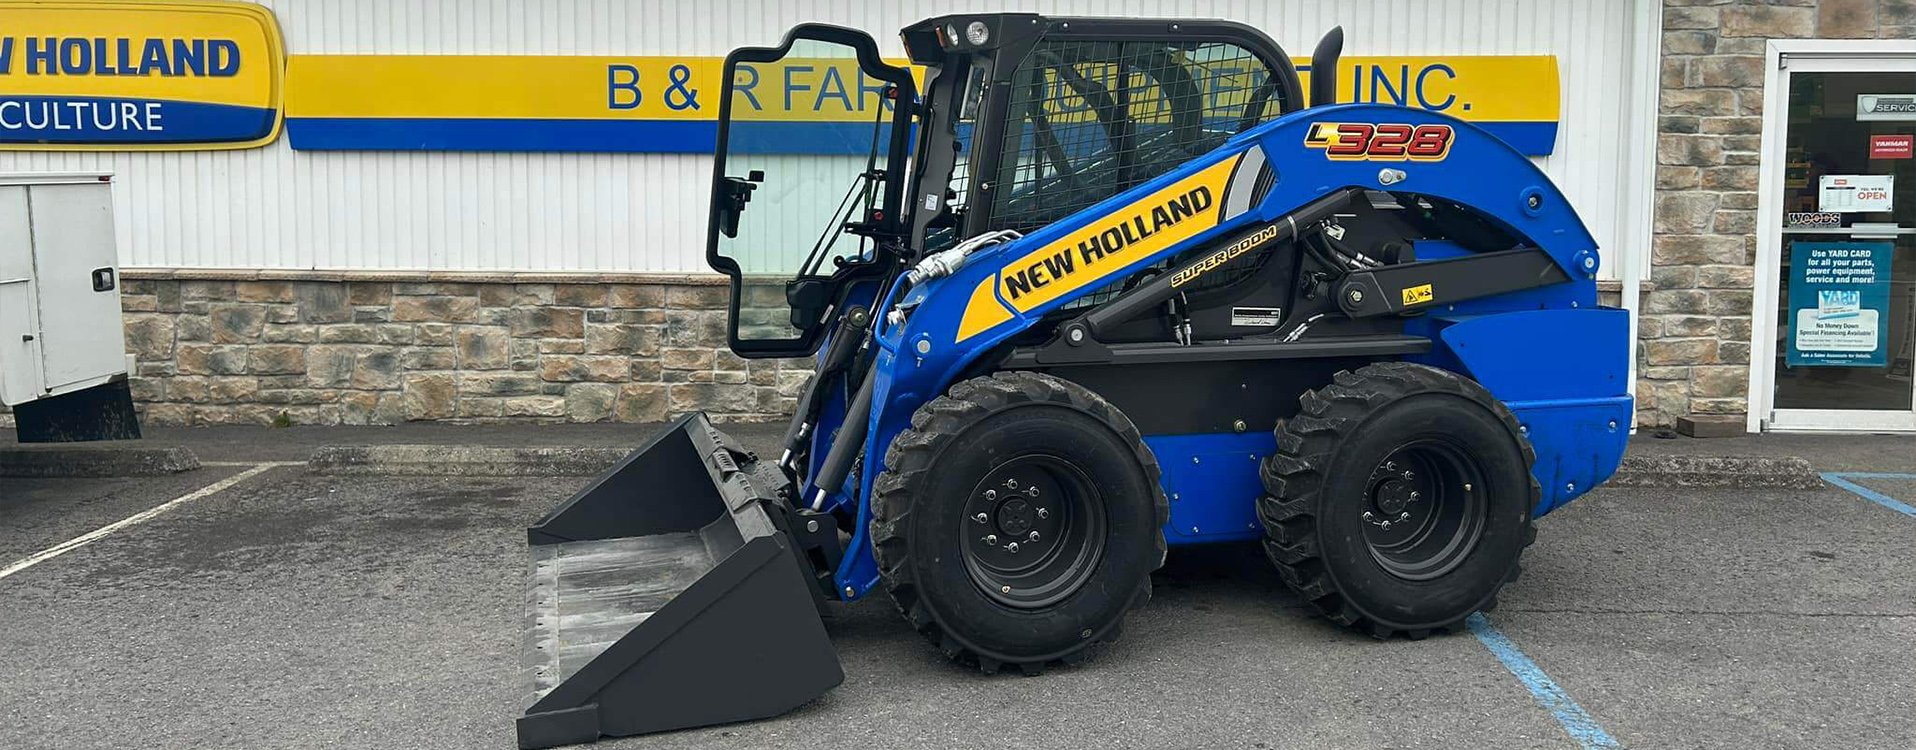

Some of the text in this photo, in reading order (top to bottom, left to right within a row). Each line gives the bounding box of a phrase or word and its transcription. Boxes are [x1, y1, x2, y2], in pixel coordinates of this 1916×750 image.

[26, 37, 241, 77] HOLLAND
[608, 64, 643, 110] B
[663, 64, 701, 111] &
[733, 65, 764, 111] R
[784, 65, 920, 112] FAR
[1353, 63, 1472, 112] INC.
[0, 101, 163, 131] CULTURE
[1857, 191, 1887, 200] OPEN
[1790, 213, 1840, 225] WOODS
[1004, 184, 1214, 300] NEW HOLLAND
[1171, 225, 1277, 288] SUPER BOOM
[1812, 249, 1872, 257] Use YARD CARD
[1808, 258, 1819, 266] for
[1821, 258, 1831, 266] all
[1852, 259, 1875, 267] parts,
[1806, 267, 1876, 276] power equipment,
[1806, 275, 1875, 283] service and more!
